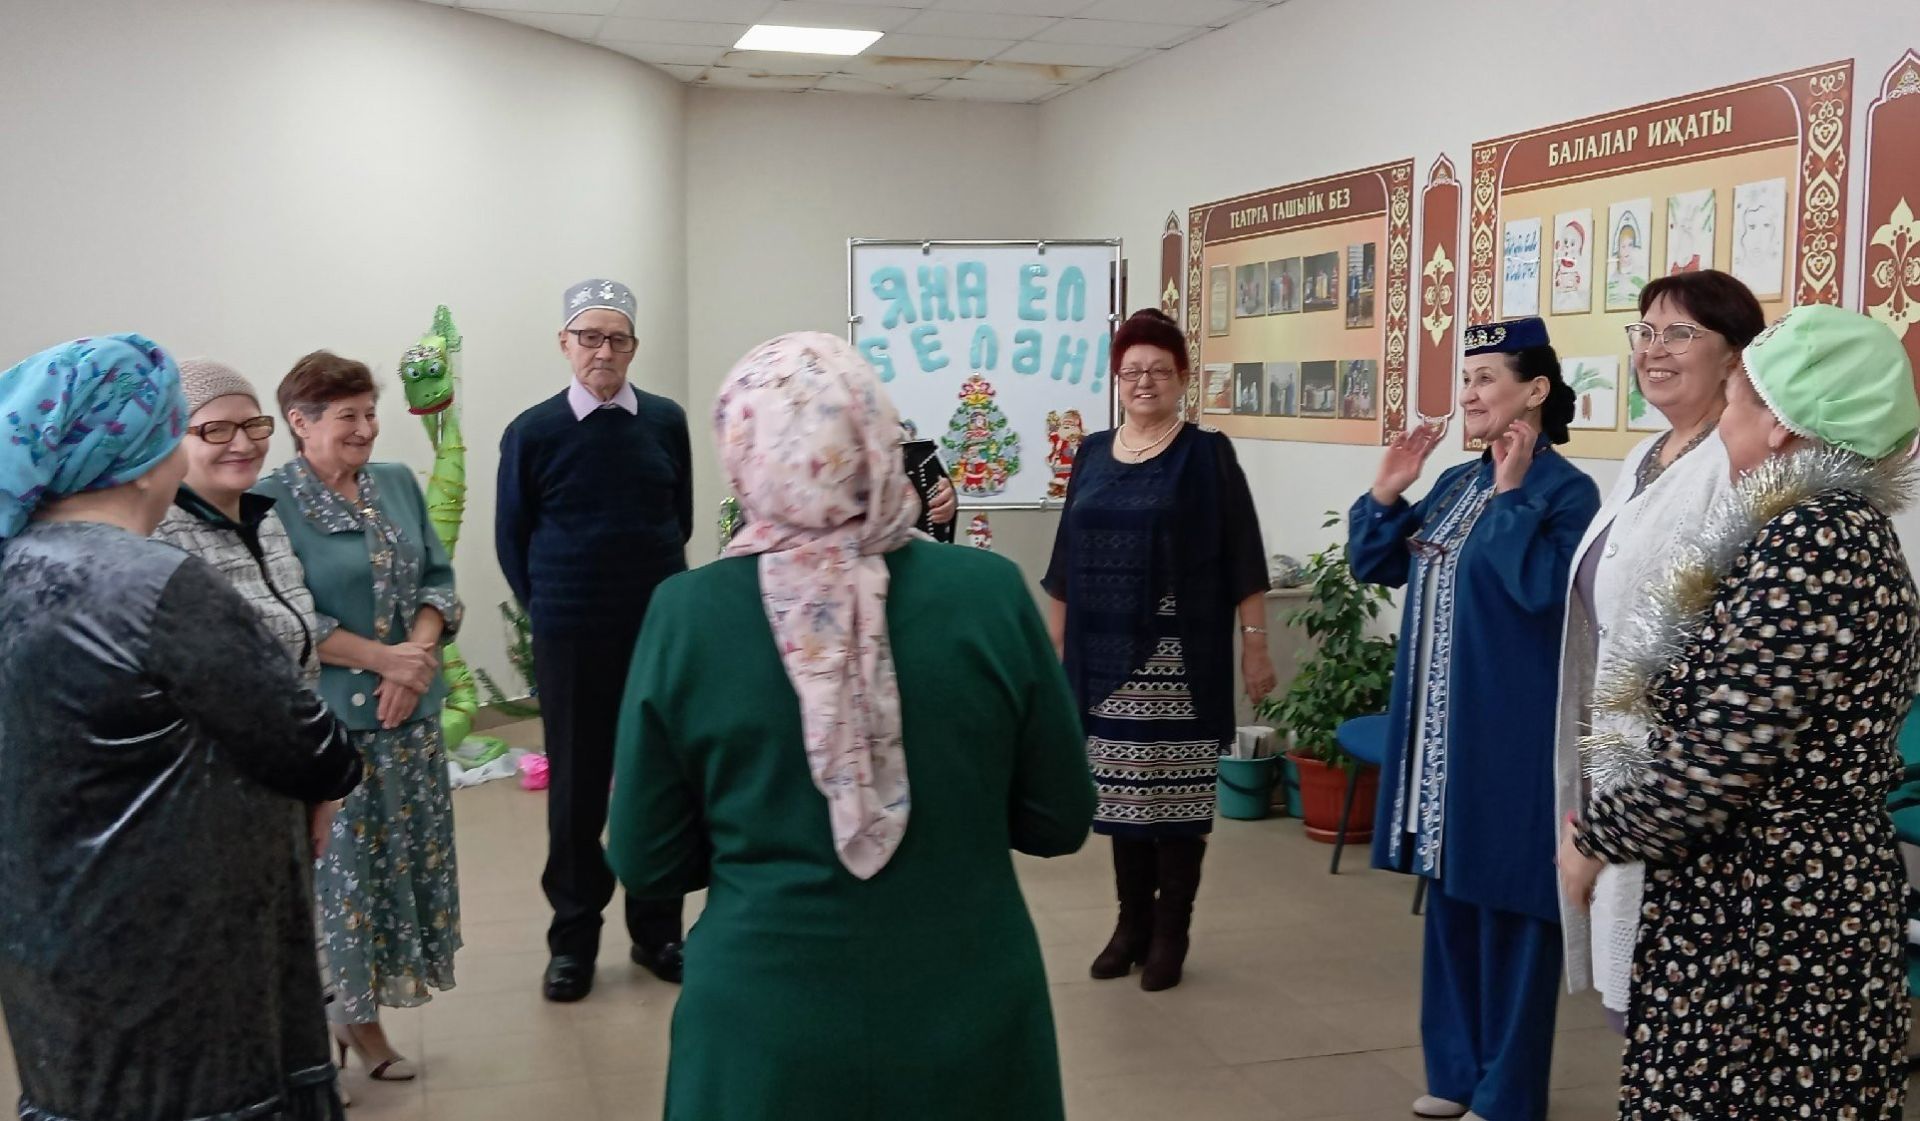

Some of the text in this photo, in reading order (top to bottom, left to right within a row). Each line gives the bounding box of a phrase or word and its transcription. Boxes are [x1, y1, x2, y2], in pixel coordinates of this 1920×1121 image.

[1549, 106, 1732, 167] БАЛАЛАР ИҖАТЫ
[1230, 188, 1351, 229] ТЕАТРГА ГАШЫЙК БЕЗ
[1018, 263, 1086, 322] ЕЛ
